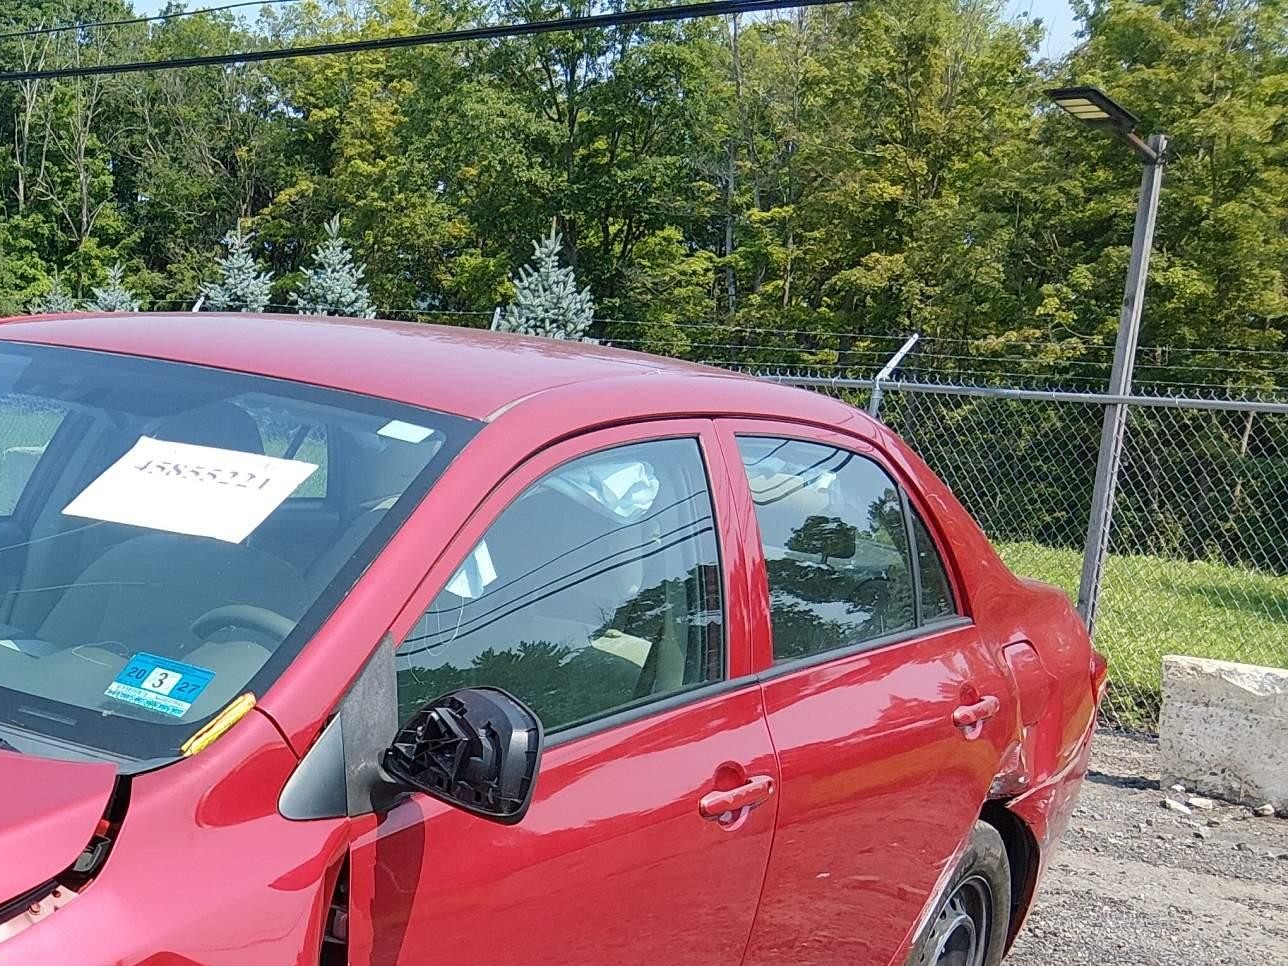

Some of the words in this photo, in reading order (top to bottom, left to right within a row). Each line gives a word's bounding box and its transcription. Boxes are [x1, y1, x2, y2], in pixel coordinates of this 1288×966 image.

[127, 667, 147, 680] 20
[152, 672, 168, 689] 3
[176, 682, 201, 694] 27
